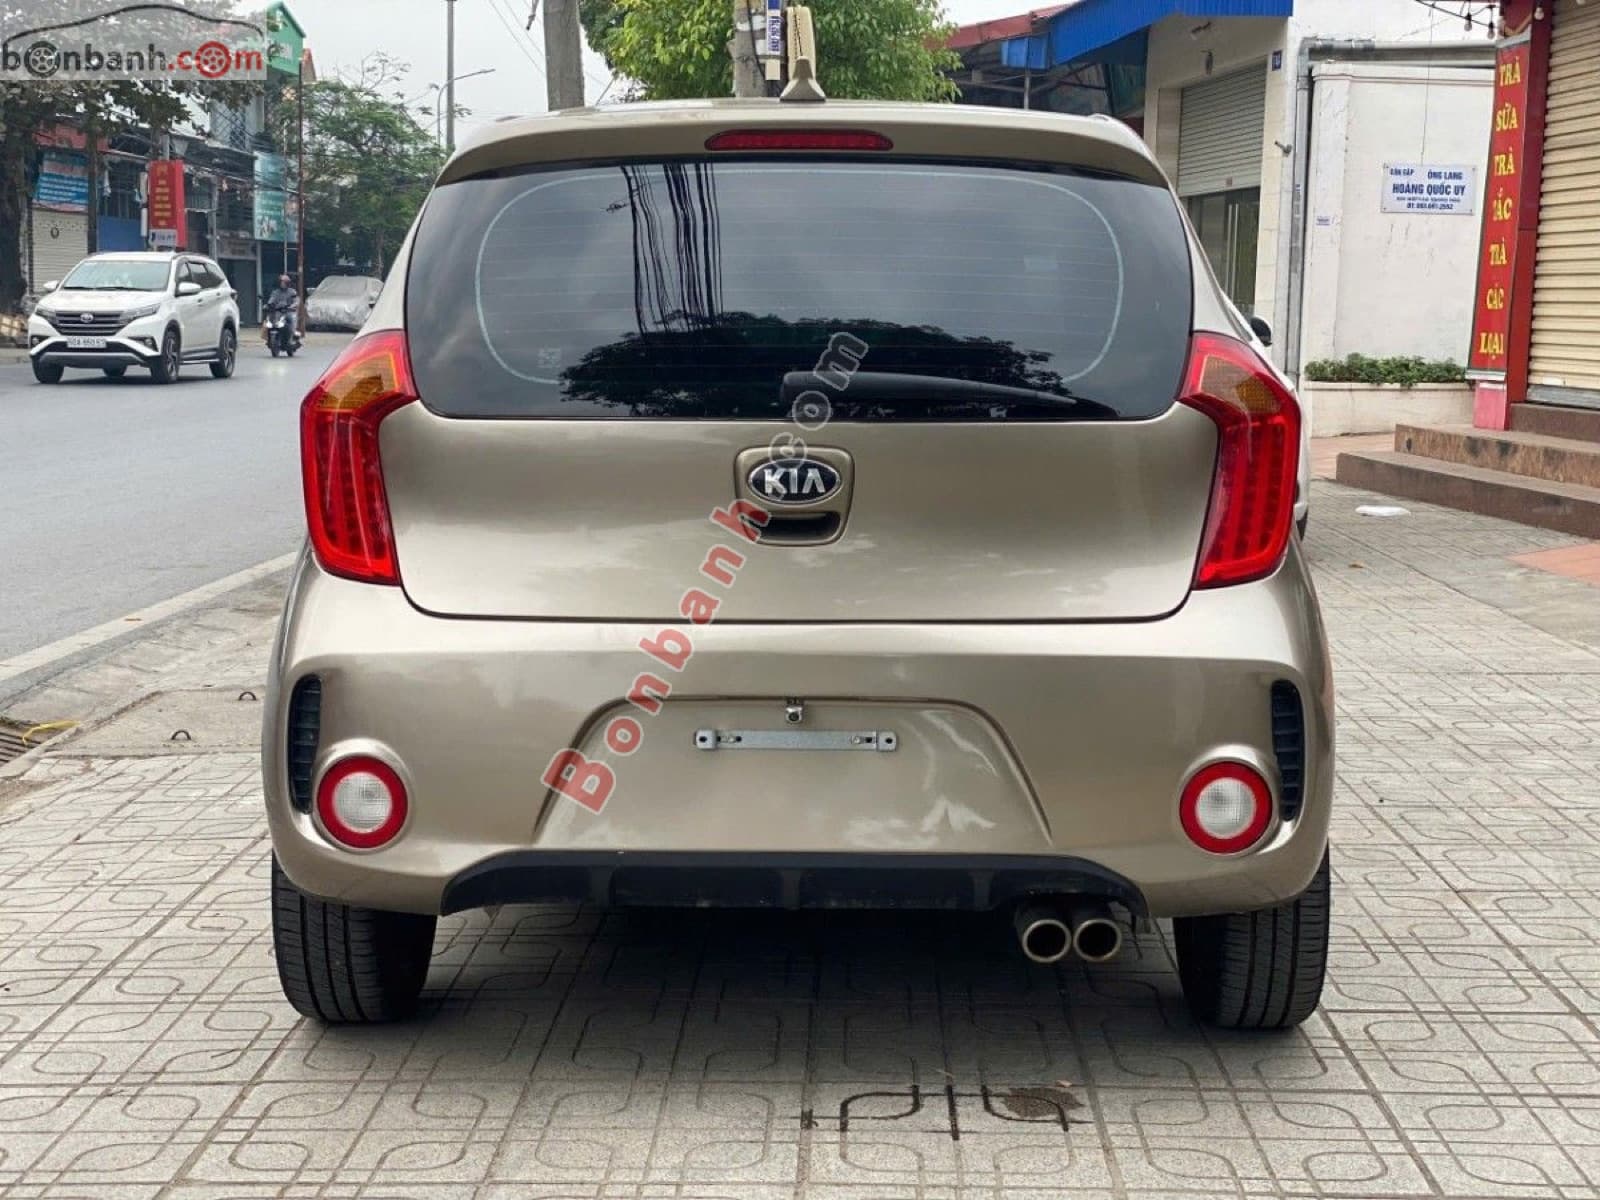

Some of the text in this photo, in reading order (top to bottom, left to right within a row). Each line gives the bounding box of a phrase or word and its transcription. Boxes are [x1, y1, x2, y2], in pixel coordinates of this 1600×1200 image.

[1499, 56, 1521, 86] TRÀ
[1392, 182, 1424, 194] HOÀNG
[1426, 181, 1452, 196] QUỐC
[763, 468, 826, 494] KIA
